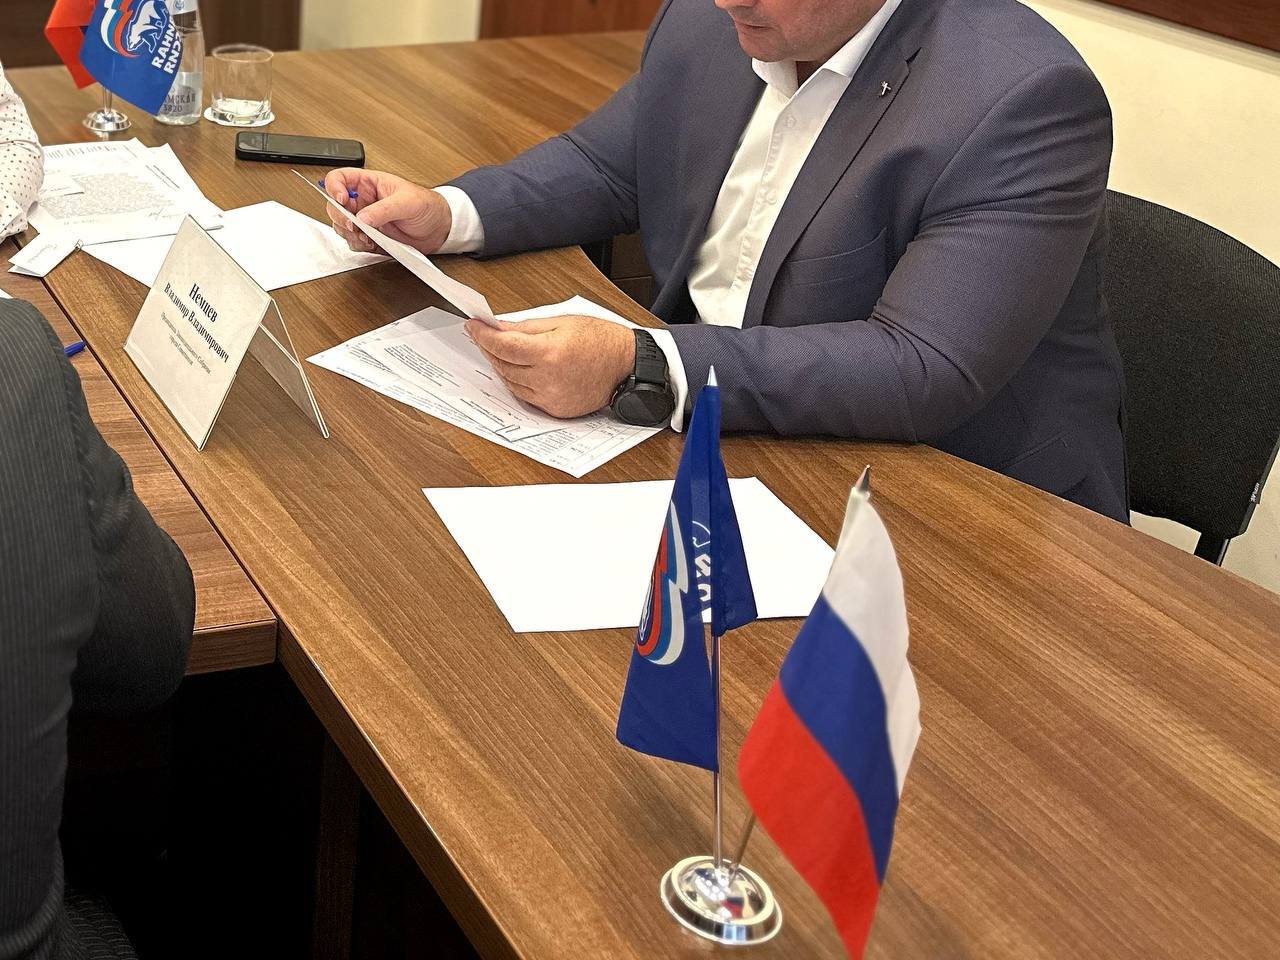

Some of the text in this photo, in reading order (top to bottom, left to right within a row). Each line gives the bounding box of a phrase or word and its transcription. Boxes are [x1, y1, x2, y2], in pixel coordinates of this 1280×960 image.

[164, 282, 190, 319] Владимир
[187, 310, 229, 363] Владимирович
[189, 283, 218, 322] Немцев
